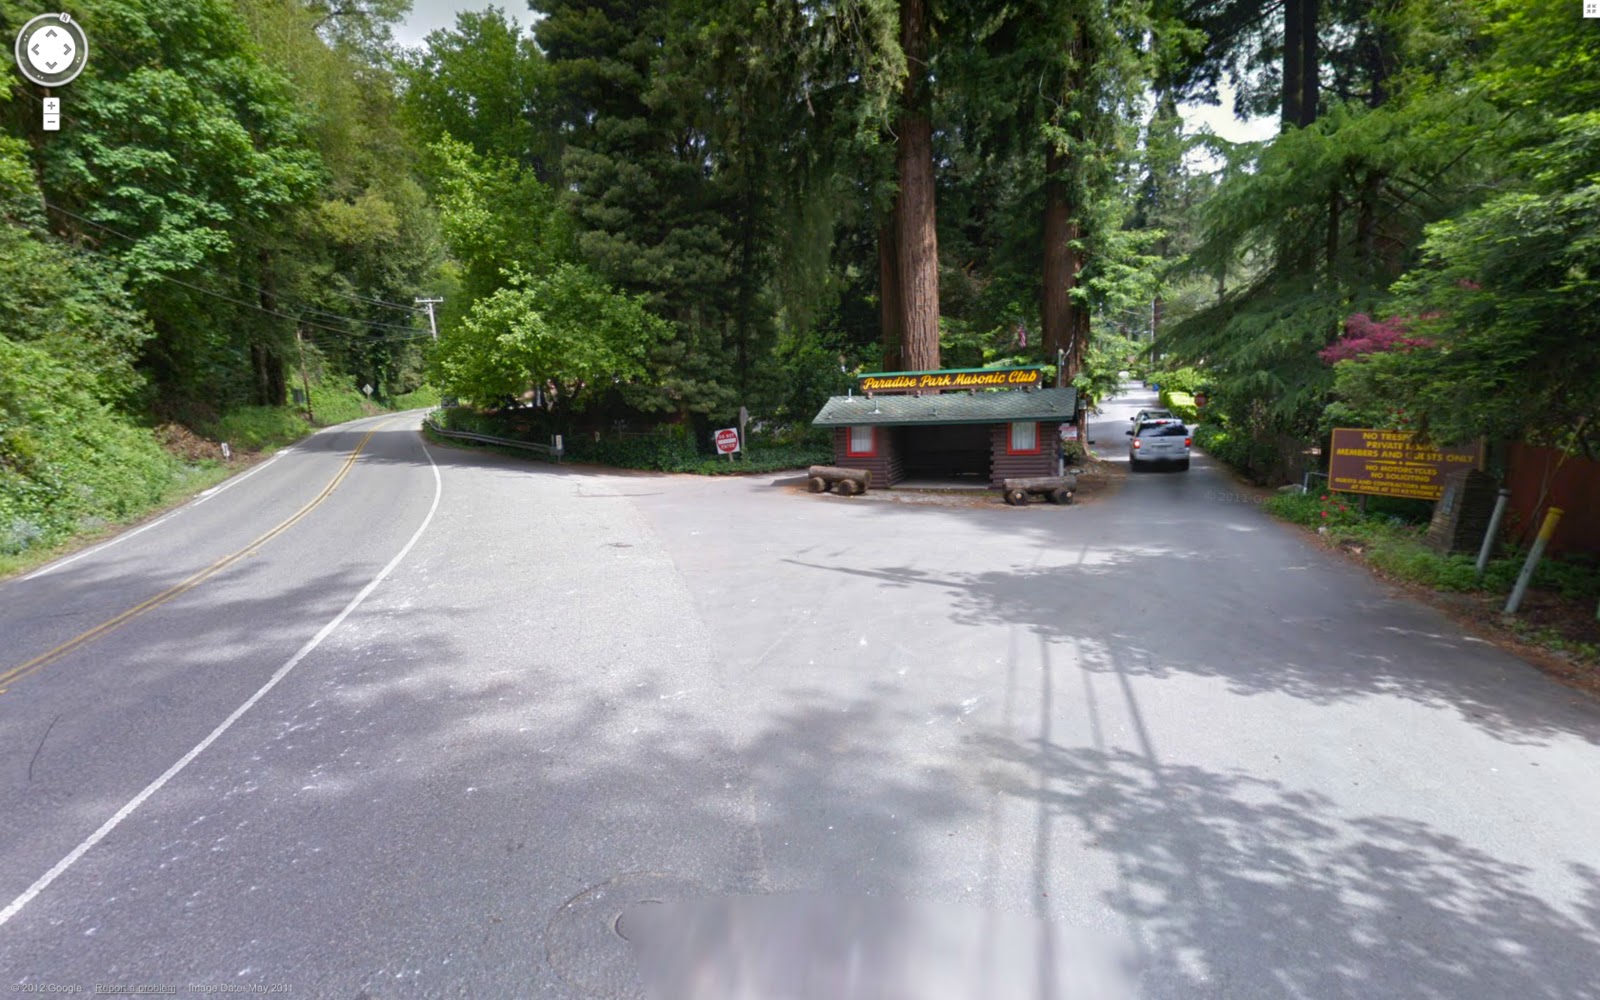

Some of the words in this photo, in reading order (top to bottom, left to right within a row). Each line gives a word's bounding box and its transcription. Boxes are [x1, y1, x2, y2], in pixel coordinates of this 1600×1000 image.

[863, 377, 917, 390] Paradise
[920, 375, 951, 387] Park
[953, 372, 1006, 386] Masonic
[1008, 370, 1037, 383] Club
[1362, 432, 1379, 440] NO
[1366, 441, 1404, 450] PRIVATE
[1336, 448, 1379, 457] MEMBERS
[1382, 450, 1403, 459] AND
[1380, 465, 1438, 476] MOTORCYCLES
[1385, 473, 1430, 483] SOLICITING
